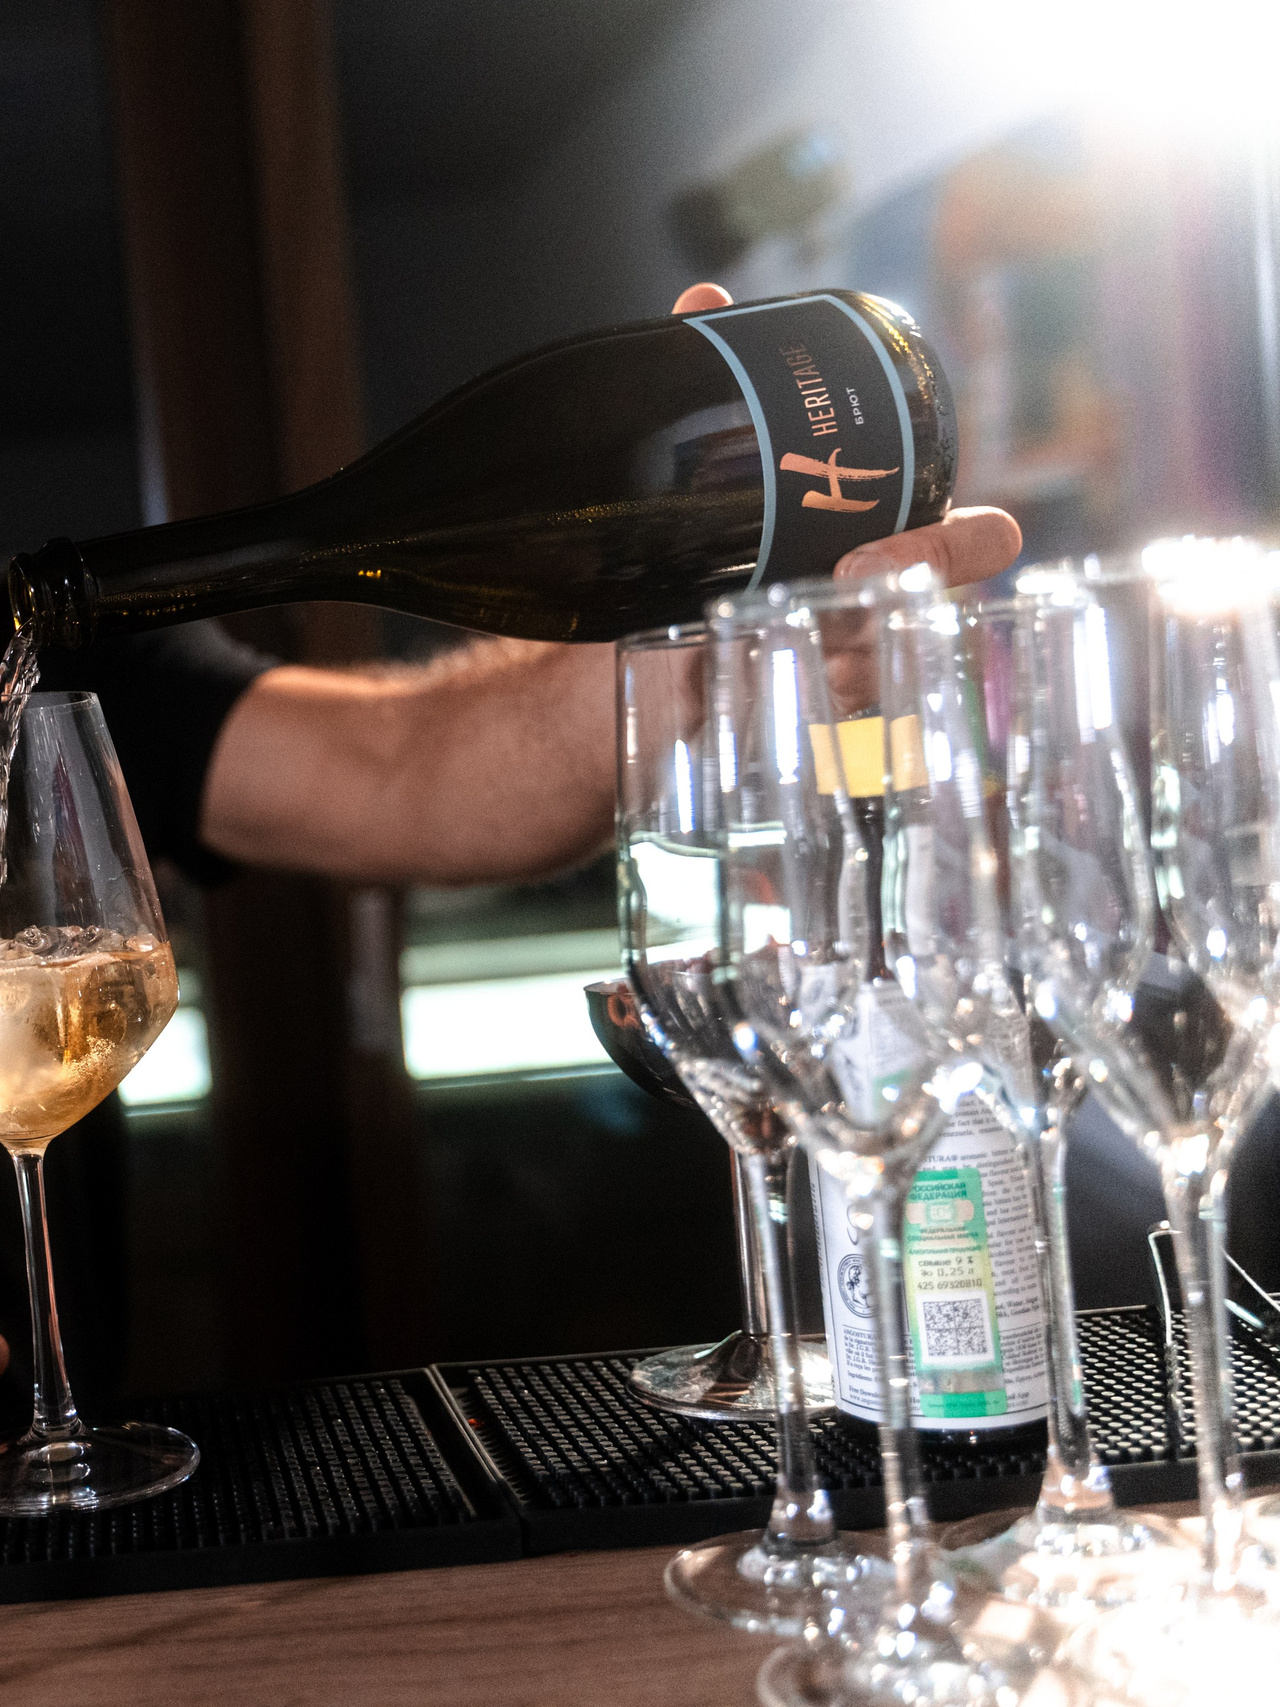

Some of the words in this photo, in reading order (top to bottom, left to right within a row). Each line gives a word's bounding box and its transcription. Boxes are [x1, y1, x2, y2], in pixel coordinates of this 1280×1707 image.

[779, 341, 838, 437] HERITAGE
[909, 1190, 967, 1200] ФЕДЕРАЦИЯ
[917, 1281, 934, 1291] 425
